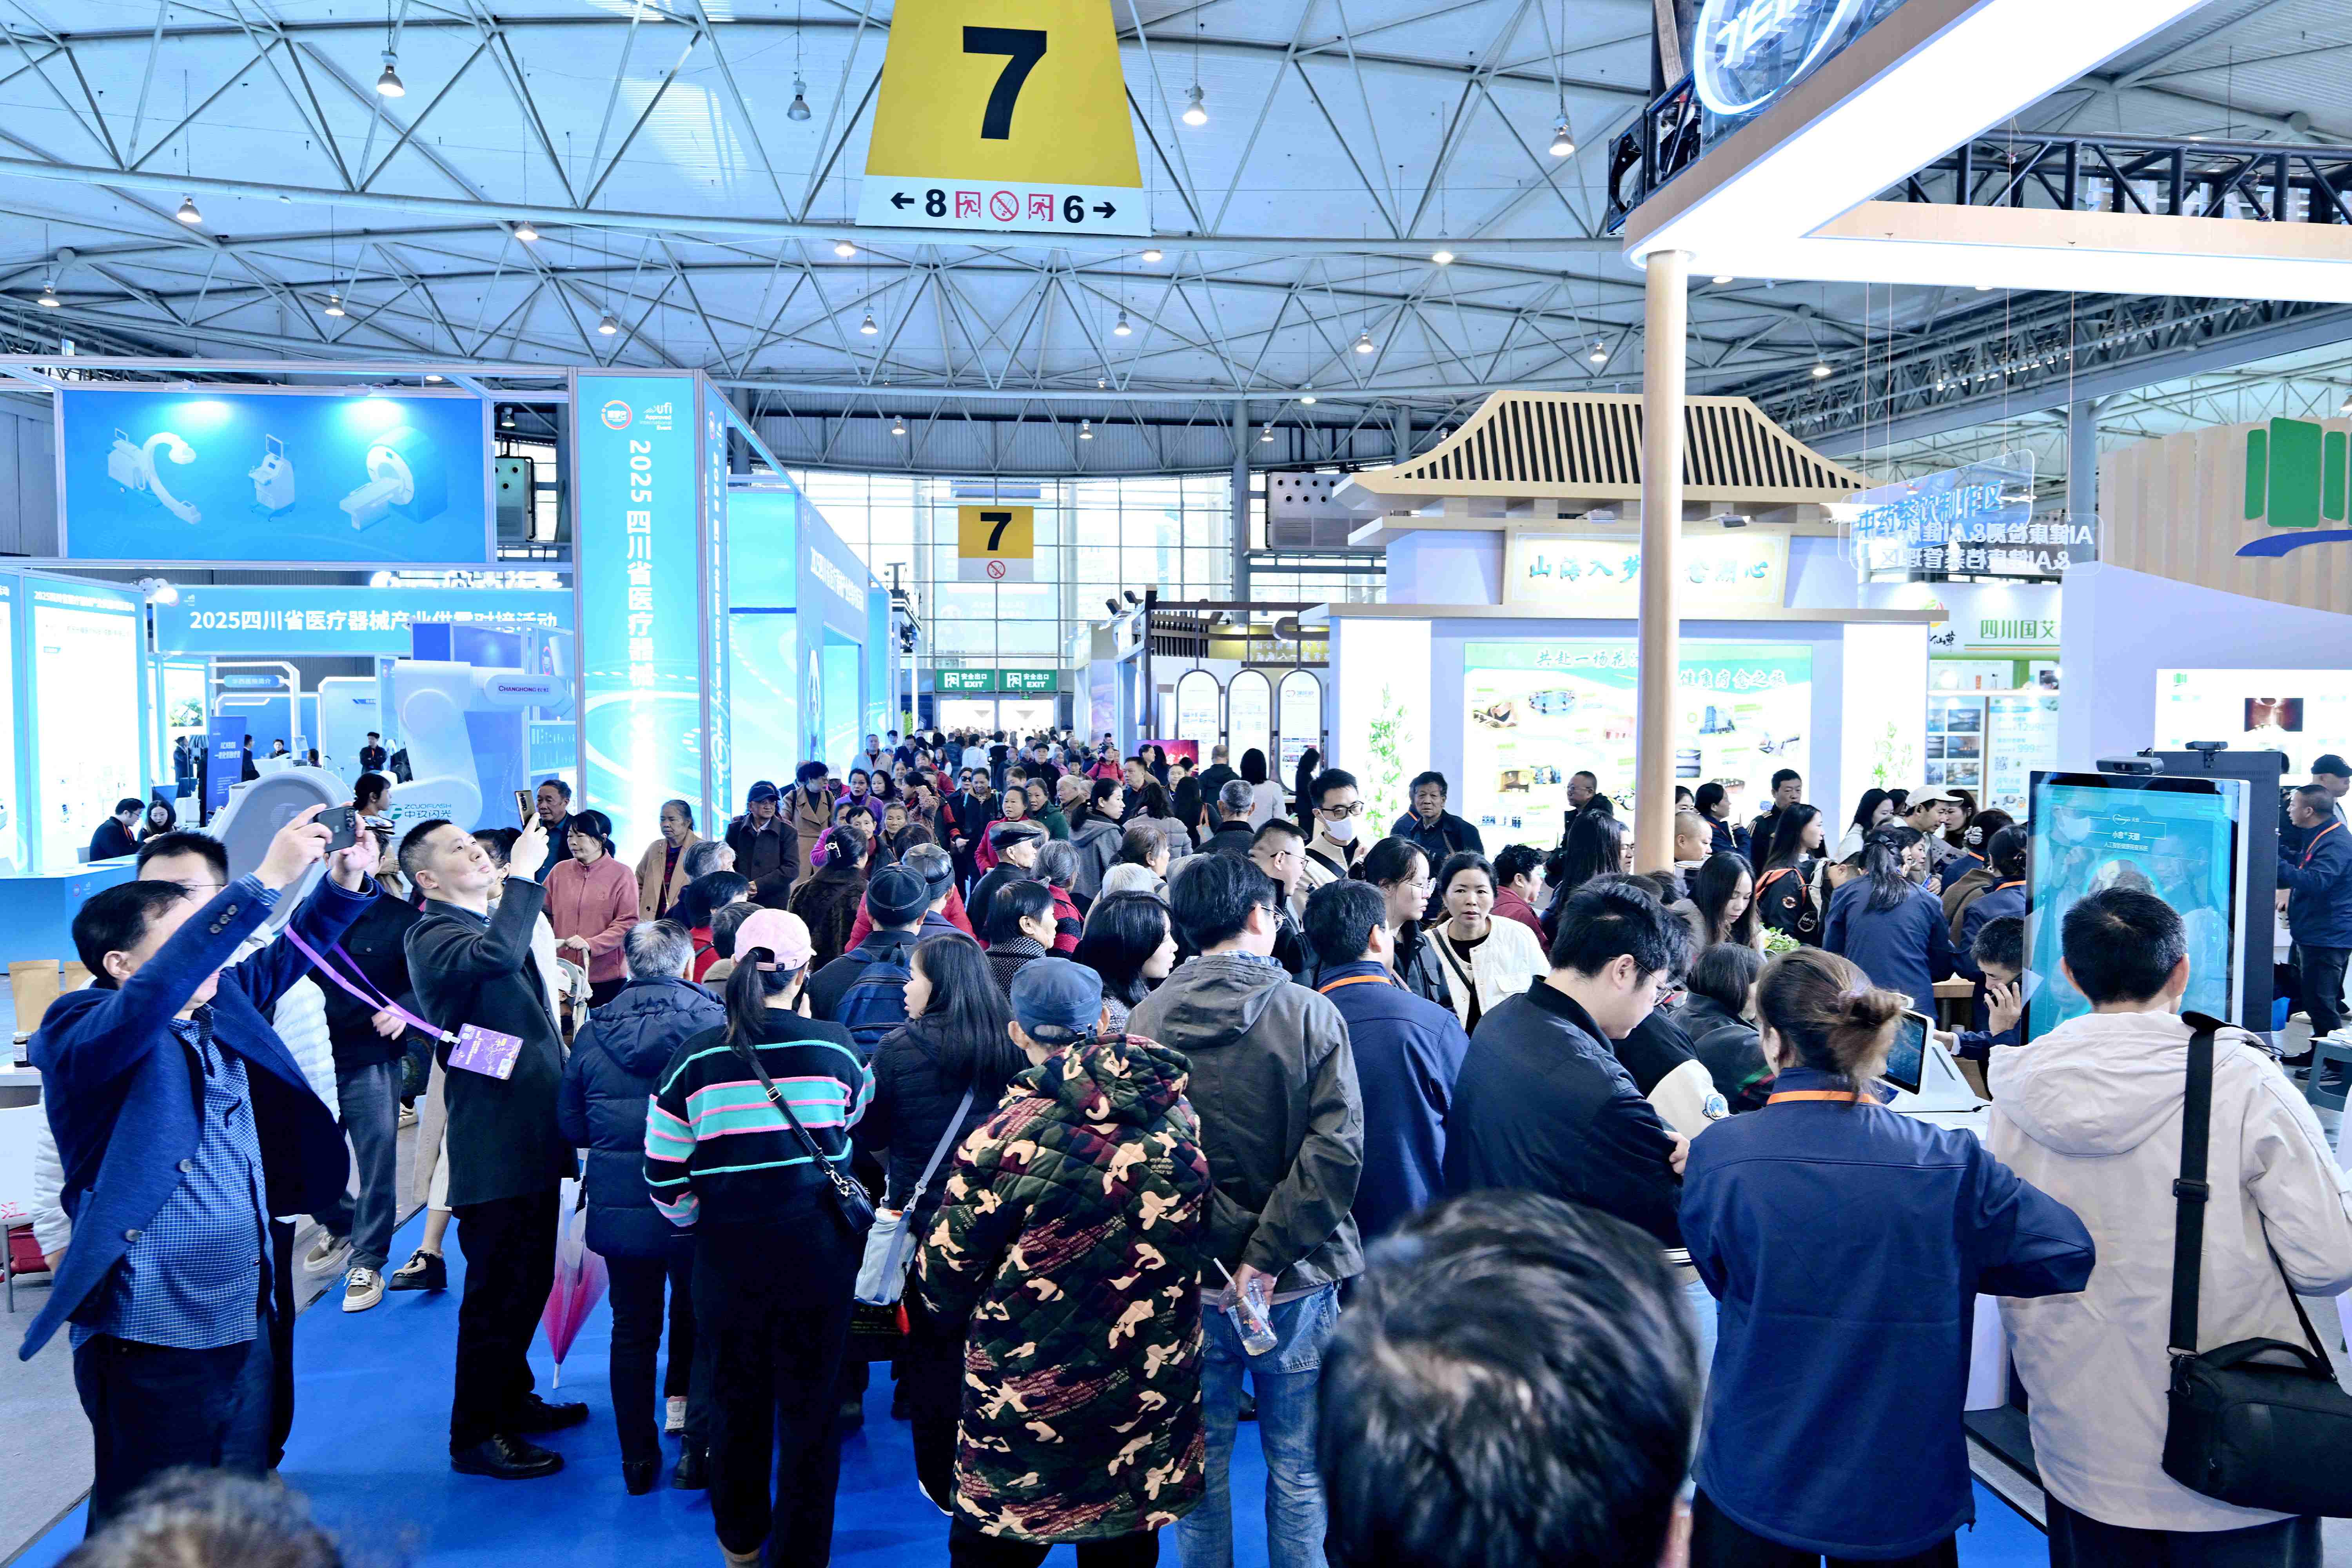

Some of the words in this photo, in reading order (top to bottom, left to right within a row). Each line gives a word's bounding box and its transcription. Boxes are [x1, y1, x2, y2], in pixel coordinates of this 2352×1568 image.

[963, 26, 1047, 140] 7
[925, 189, 947, 217] 8
[1063, 195, 1084, 223] 6
[1858, 480, 2004, 535] 中药茶饮制作区
[980, 512, 1012, 550] 7
[1980, 620, 2057, 639] 四川国艾
[405, 810, 452, 818] 中玖闪光
